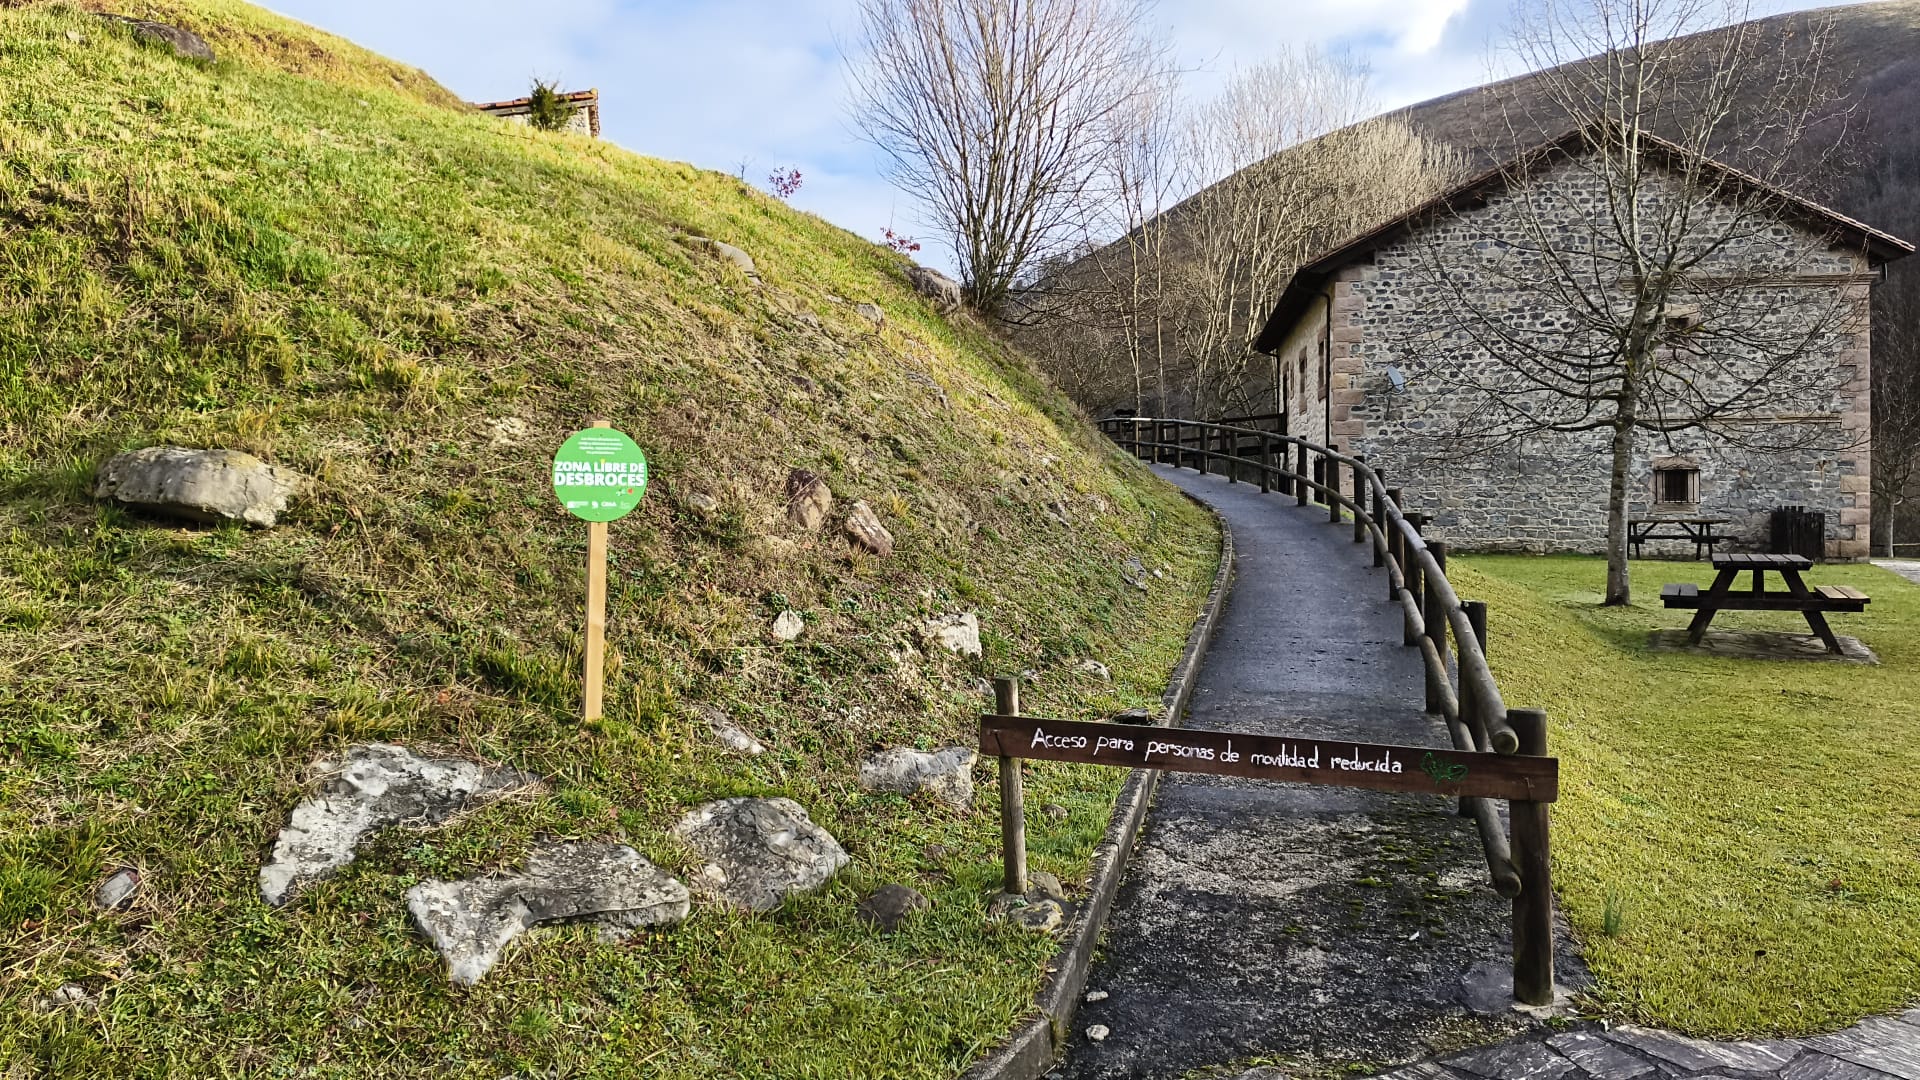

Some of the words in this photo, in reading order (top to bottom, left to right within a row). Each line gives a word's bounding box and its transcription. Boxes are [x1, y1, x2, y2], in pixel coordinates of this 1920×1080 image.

[555, 461, 592, 472] ZONA
[594, 461, 627, 473] LIBRE
[630, 463, 645, 473] DE
[555, 473, 645, 487] DESBROCES
[1031, 727, 1087, 749] Acceso
[1093, 735, 1134, 756] para
[1145, 740, 1215, 761] personas
[1219, 740, 1240, 763] de
[1250, 743, 1319, 769] movilidad
[1330, 746, 1402, 773] reducida
